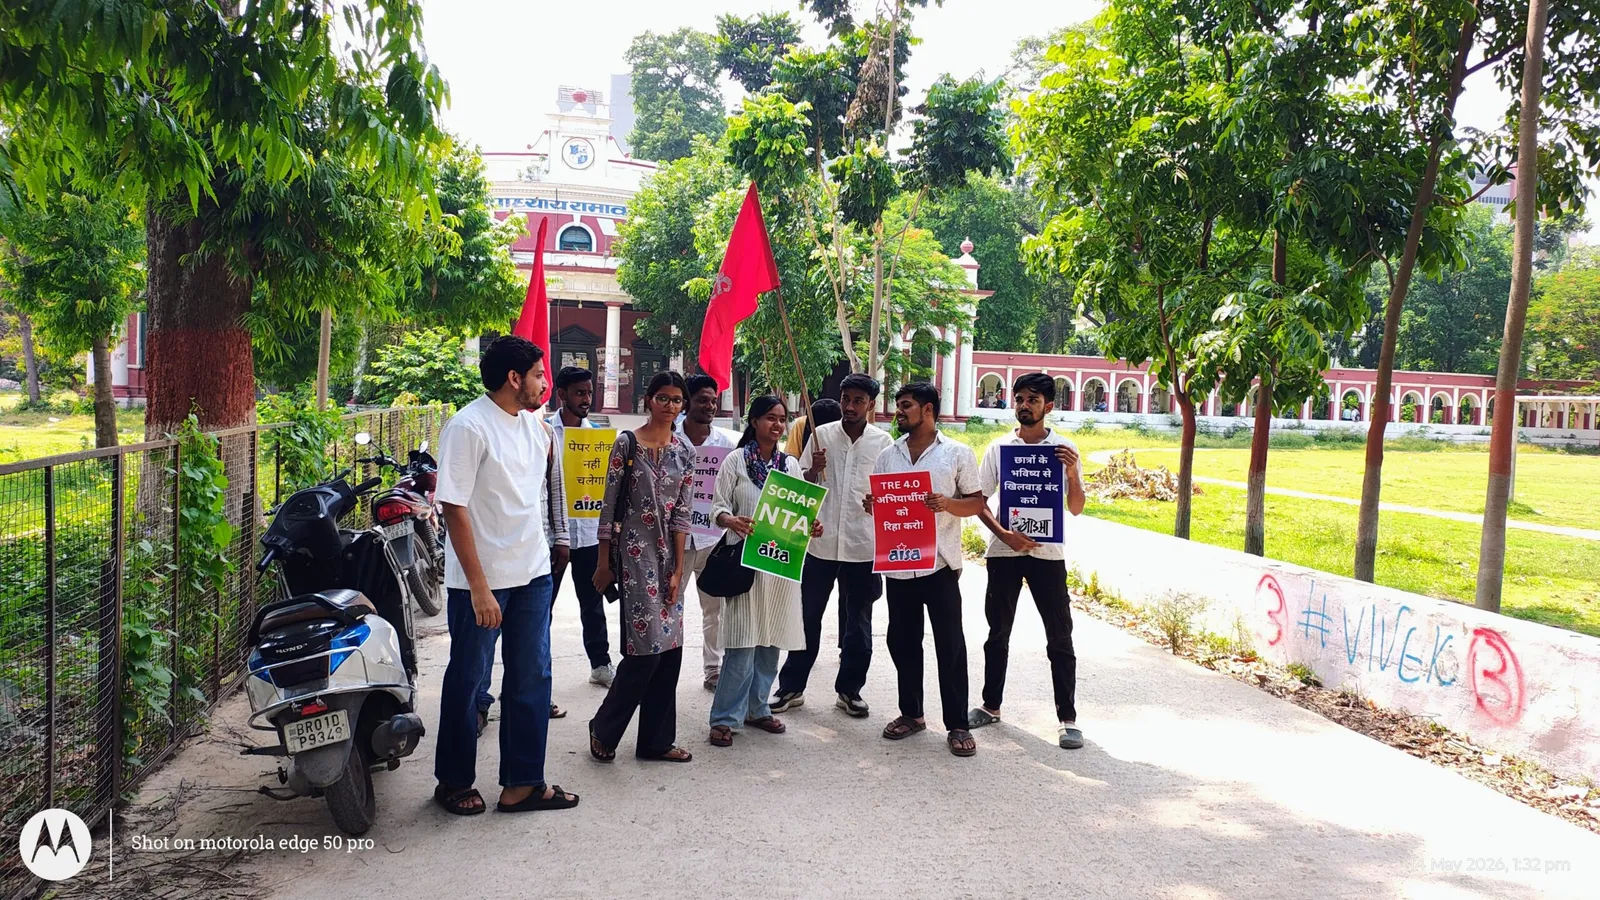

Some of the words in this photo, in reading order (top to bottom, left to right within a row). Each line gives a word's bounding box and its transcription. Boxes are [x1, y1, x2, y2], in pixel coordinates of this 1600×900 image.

[569, 200, 627, 215] रामाव
[568, 440, 591, 452] पेपर
[702, 456, 718, 465] 4.0
[1013, 454, 1037, 464] छात्रों
[1038, 454, 1048, 464] के
[1011, 467, 1040, 477] भविष्य
[1042, 468, 1052, 478] से
[576, 474, 605, 485] चलेगा
[880, 481, 901, 490] TRE
[903, 480, 920, 489] 4.0
[1004, 480, 1043, 493] खिलवाड़
[1044, 482, 1059, 492] बंद
[767, 484, 818, 508] SCRAP
[1020, 495, 1039, 504] करो
[896, 506, 909, 516] को
[758, 502, 809, 536] NTA
[883, 520, 901, 532] रिहा
[903, 519, 924, 530] करो!
[758, 542, 790, 563] aisa
[889, 546, 921, 561] aisa
[296, 714, 340, 736] BR01D
